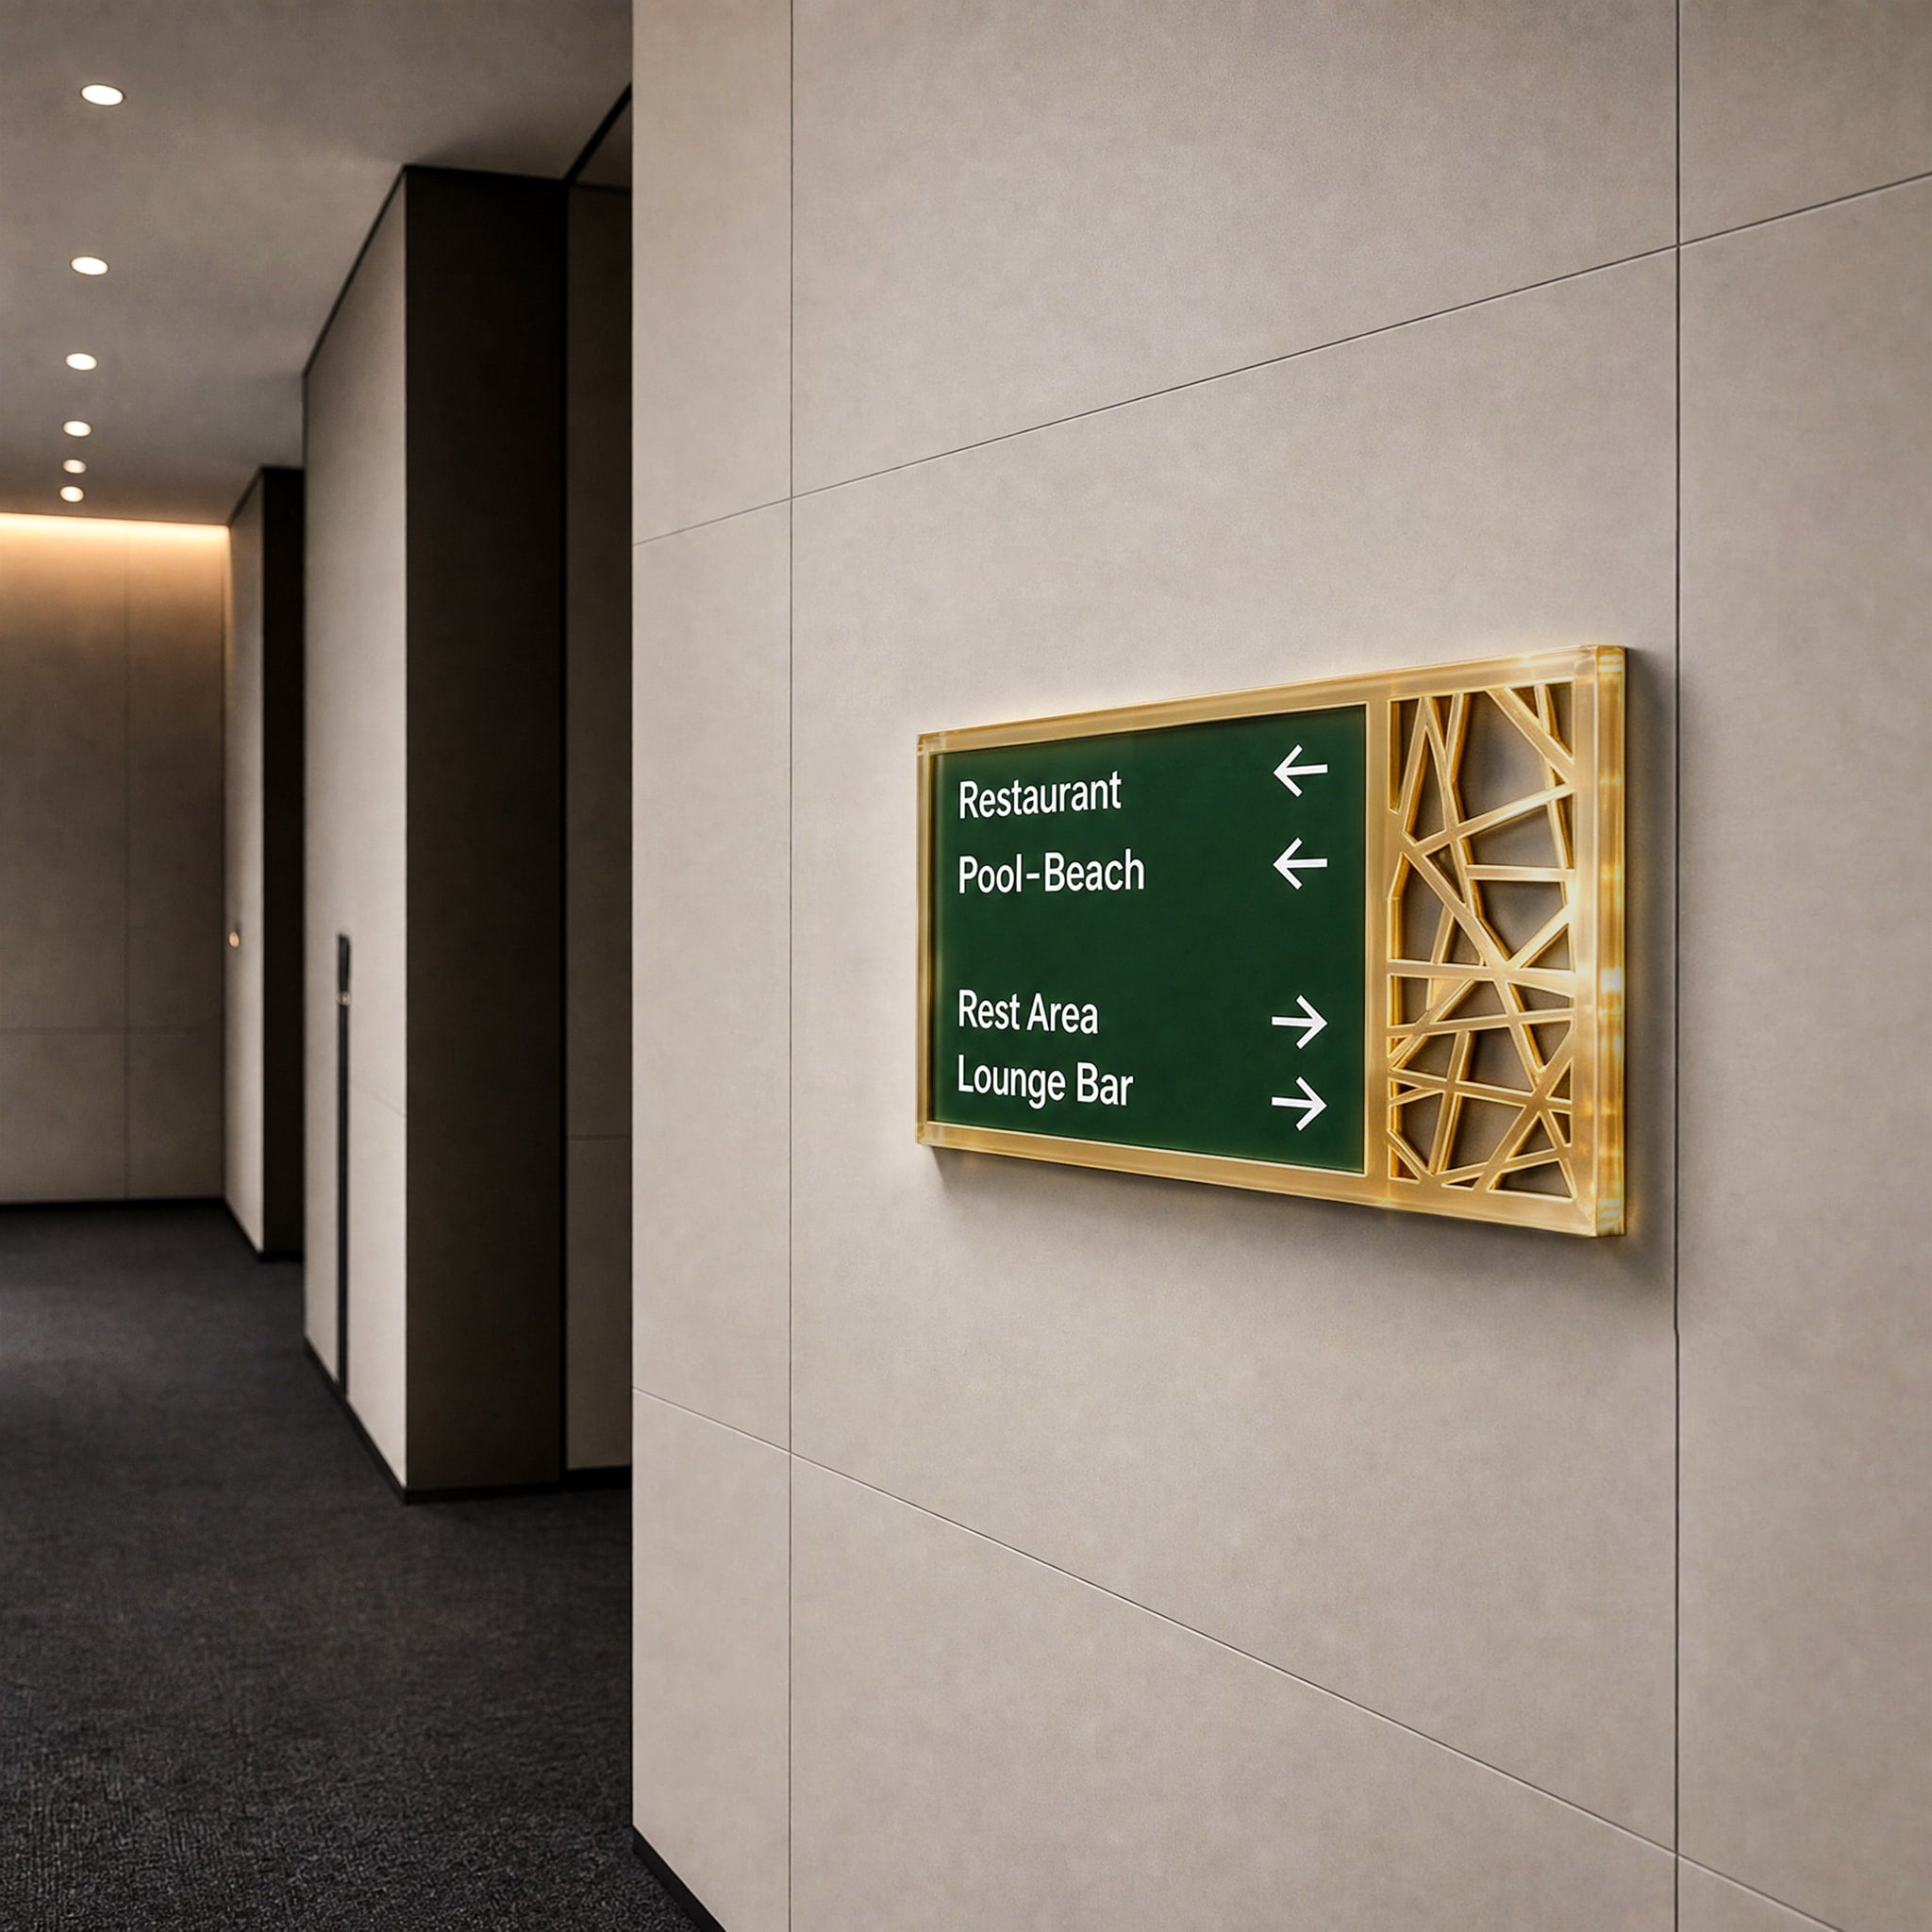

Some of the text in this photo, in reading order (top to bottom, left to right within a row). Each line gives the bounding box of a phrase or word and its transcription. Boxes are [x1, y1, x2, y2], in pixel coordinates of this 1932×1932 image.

[959, 770, 1122, 819] Restaurant
[958, 848, 1144, 894] Pool-Beach
[958, 989, 1098, 1035] Rest Area
[958, 1054, 1134, 1109] Lounge Bar
